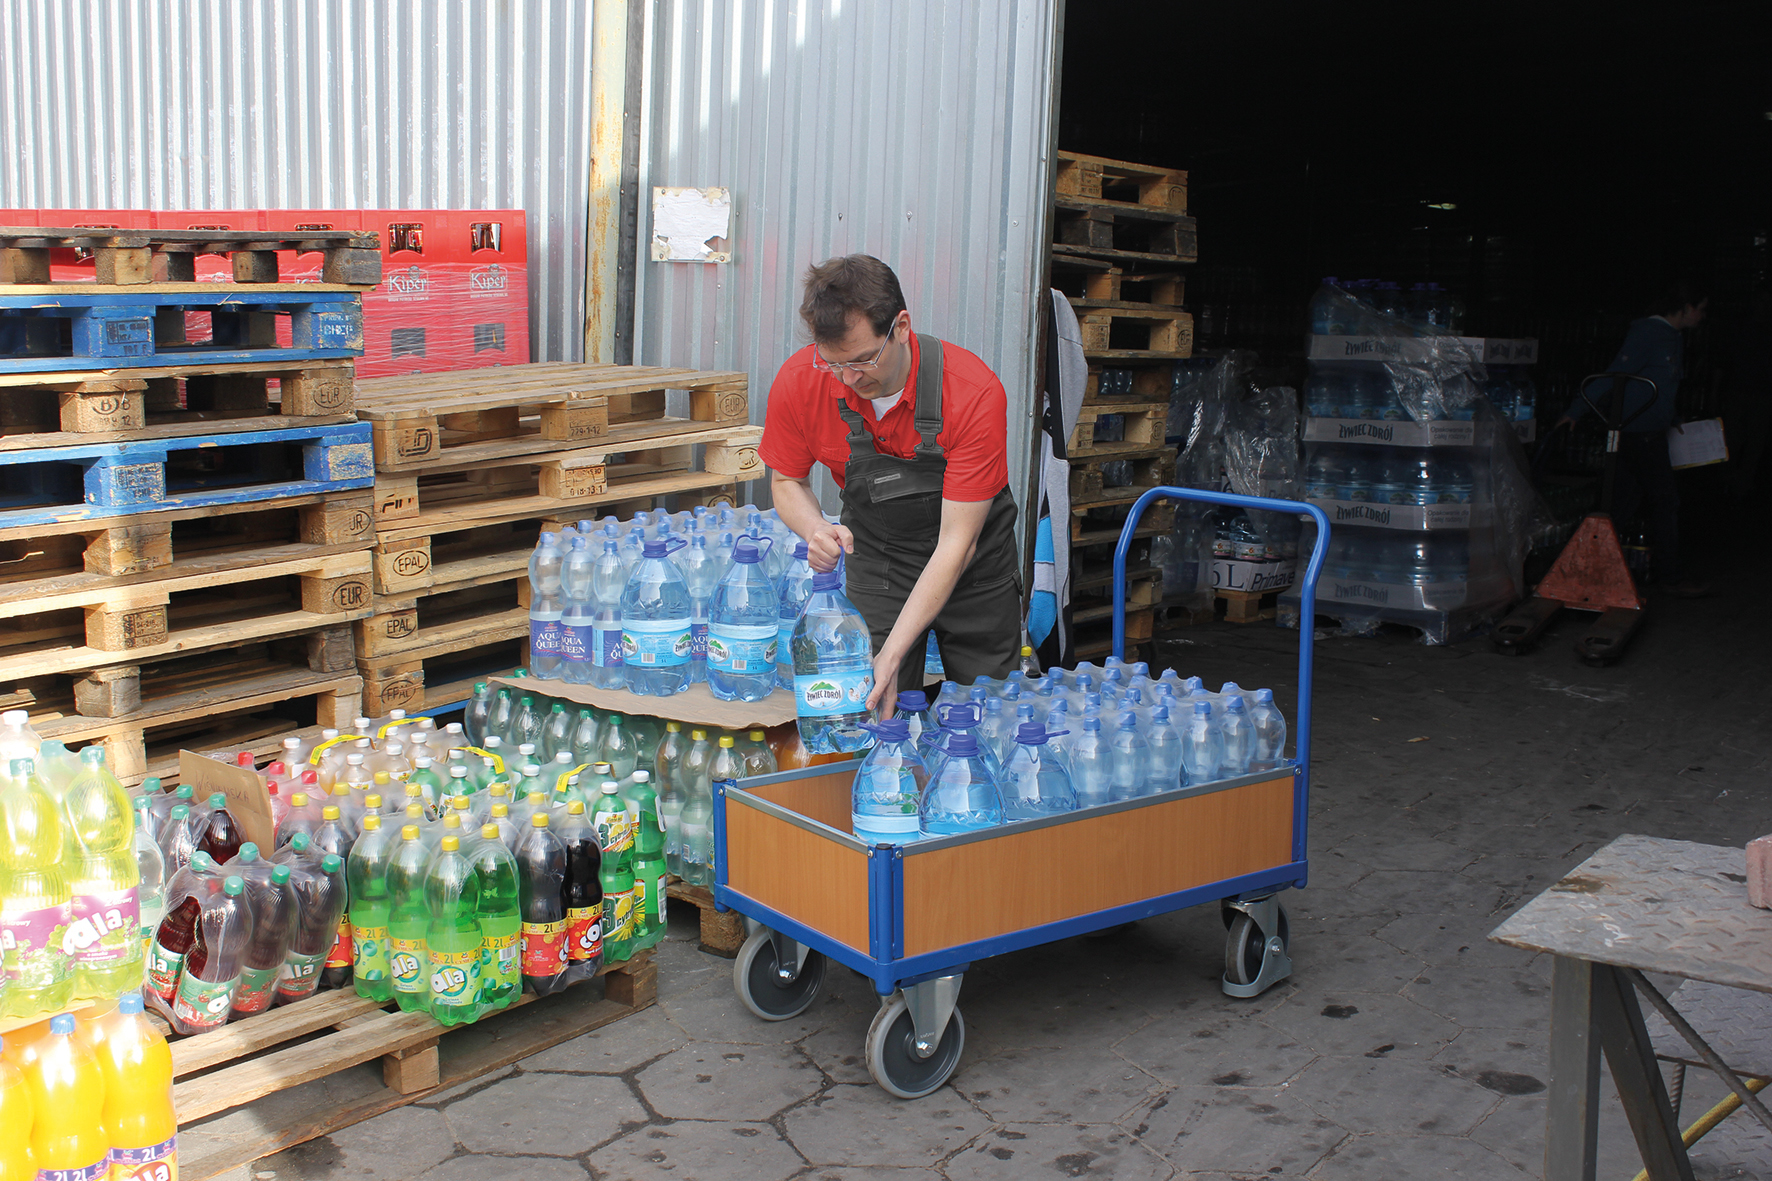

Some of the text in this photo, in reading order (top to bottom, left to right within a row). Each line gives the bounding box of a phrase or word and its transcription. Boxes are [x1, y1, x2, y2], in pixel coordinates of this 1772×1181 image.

[389, 275, 427, 293] Kiper
[471, 273, 506, 290] Kiper
[320, 387, 340, 404] EUR
[1338, 423, 1394, 441] ŻYWIEC ZDRÓJ
[1336, 505, 1391, 525] ŻYWIEC ZDRÓJ
[398, 555, 424, 573] EPAL
[340, 586, 362, 606] EUR
[1334, 583, 1389, 603] ŻYWIEC ZDRÓJ
[387, 618, 412, 634] EPAL
[806, 689, 842, 701] ŻYWIEC ZDRÓJ
[366, 928, 376, 938] 2l
[544, 923, 553, 933] 2l
[481, 937, 503, 948] 2l 2l
[444, 953, 454, 964] 2l
[431, 969, 465, 993] ala
[141, 1148, 156, 1162] 2l
